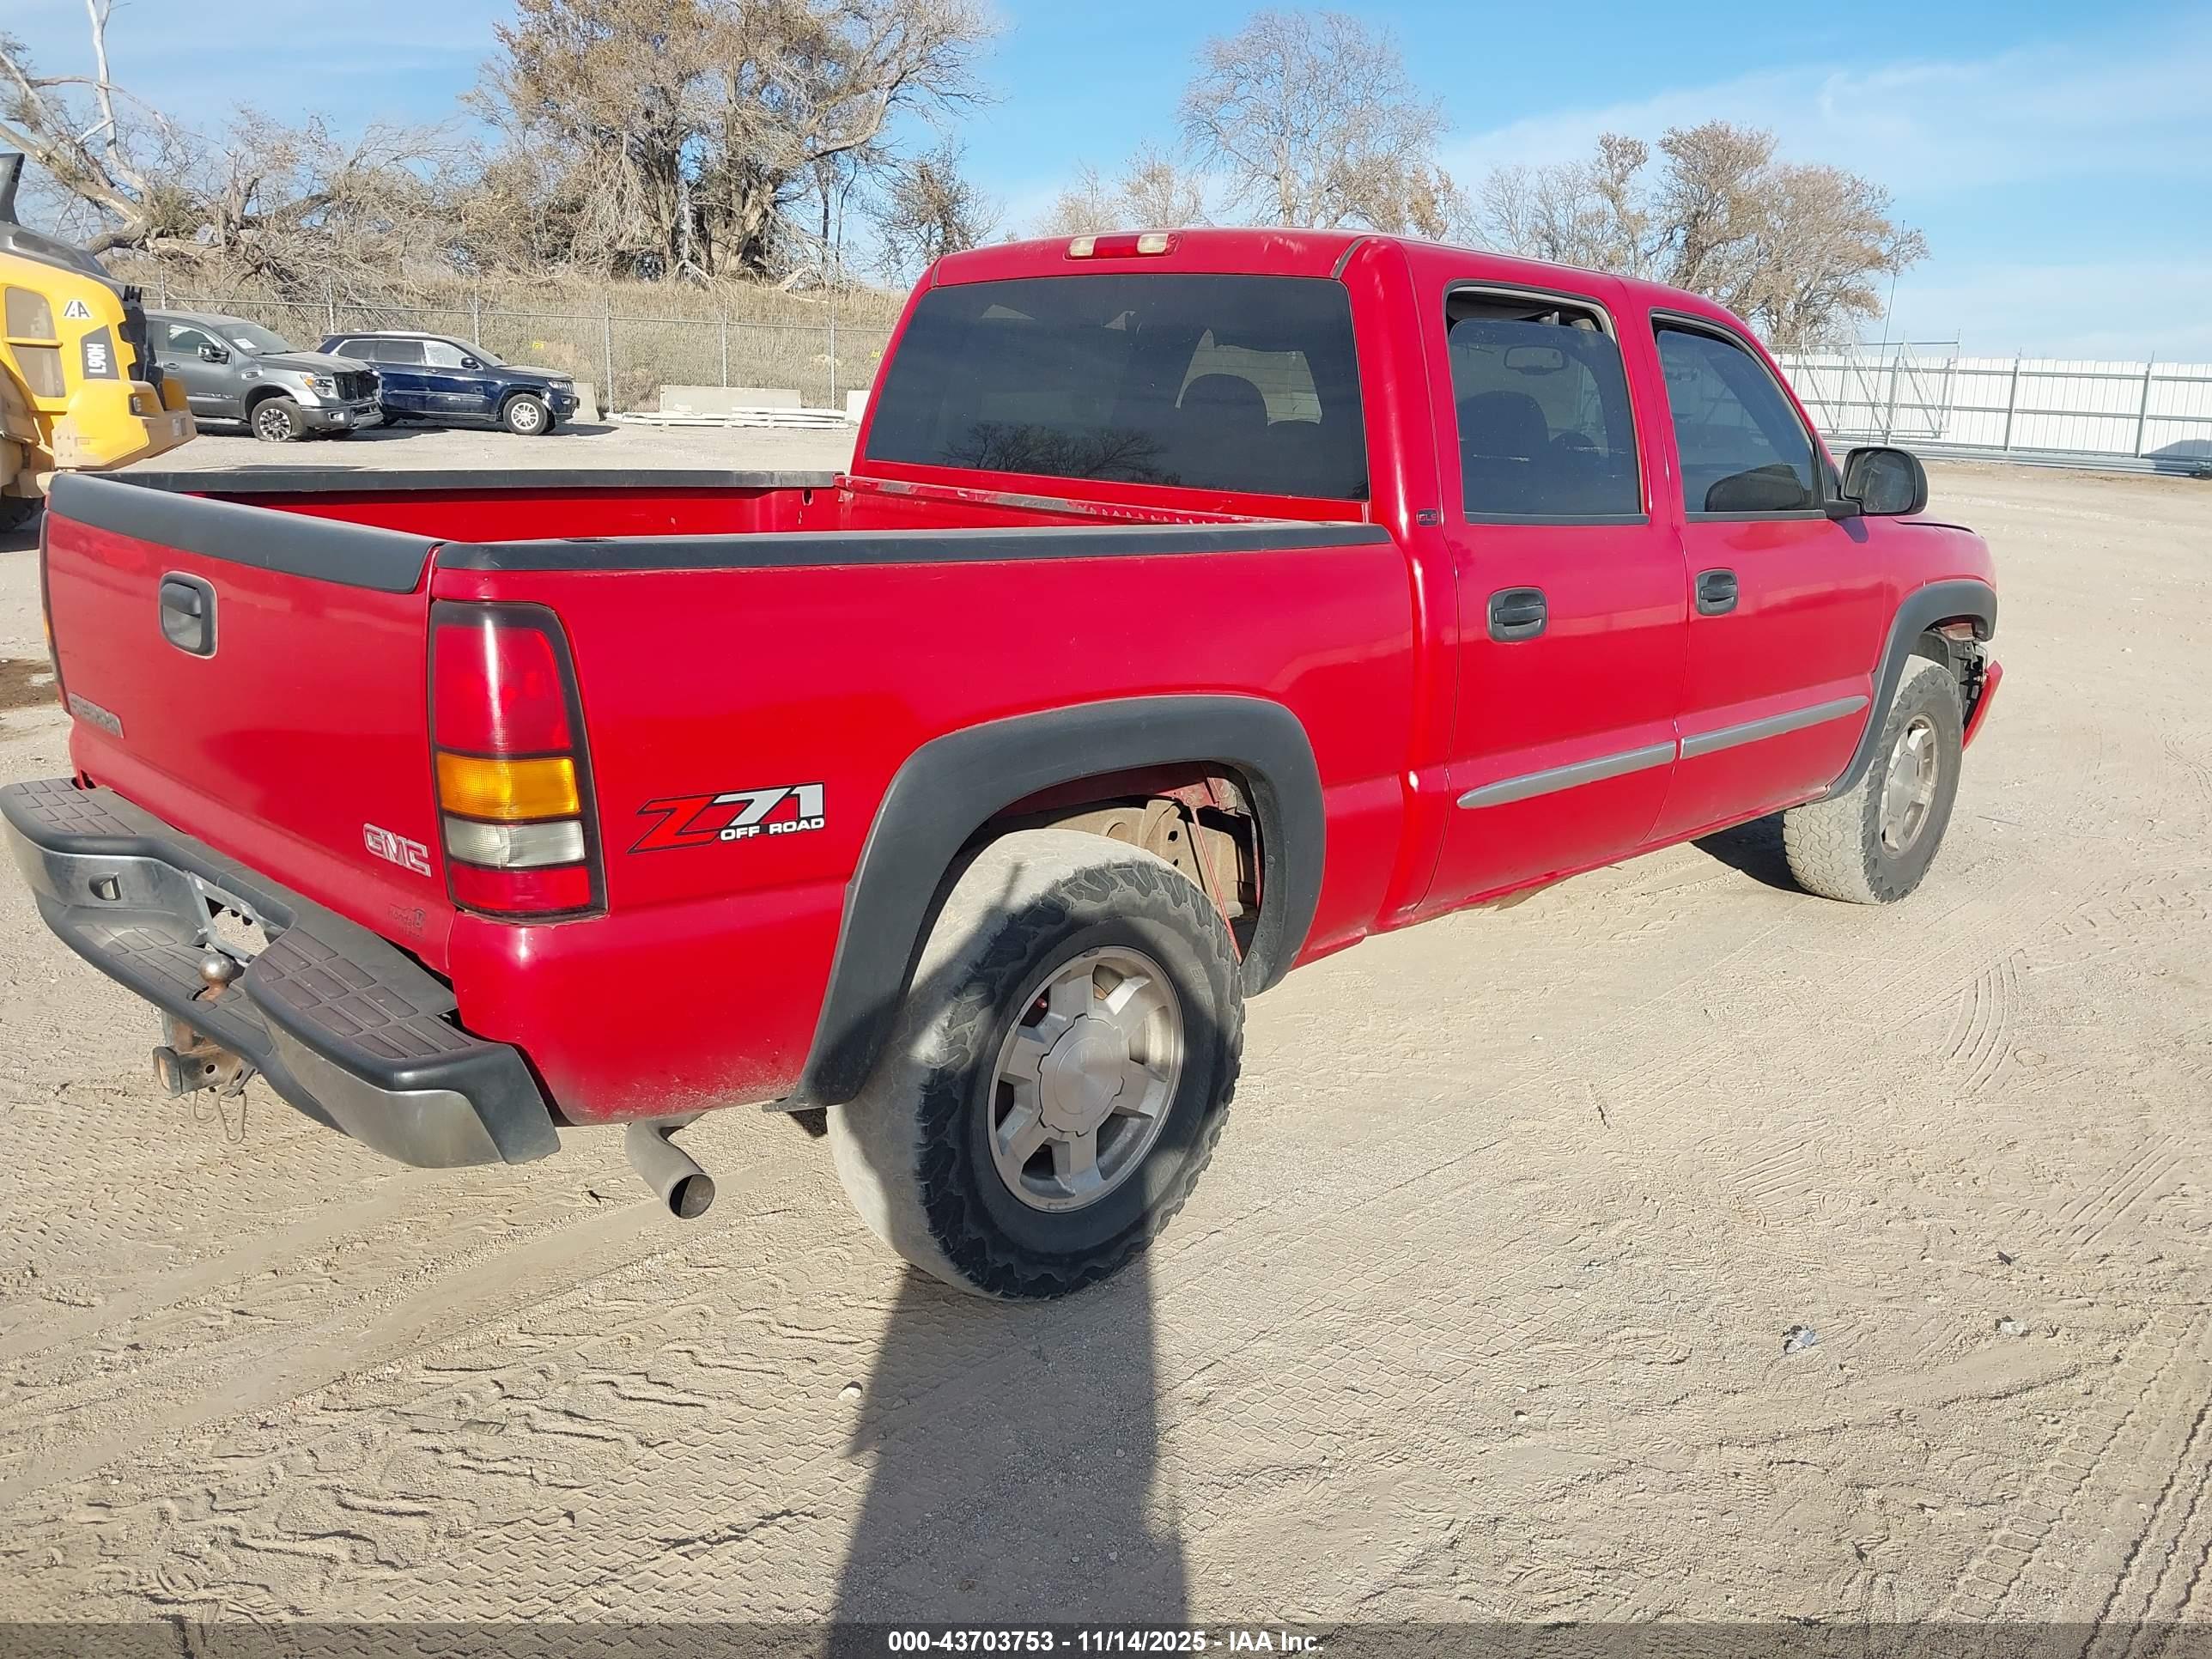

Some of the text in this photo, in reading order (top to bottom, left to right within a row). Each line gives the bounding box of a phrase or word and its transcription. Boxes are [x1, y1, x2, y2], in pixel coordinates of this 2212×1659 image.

[87, 343, 106, 373] L90H
[627, 782, 824, 854] Z71
[720, 817, 825, 842] OFF ROAD
[363, 823, 432, 878] GMC
